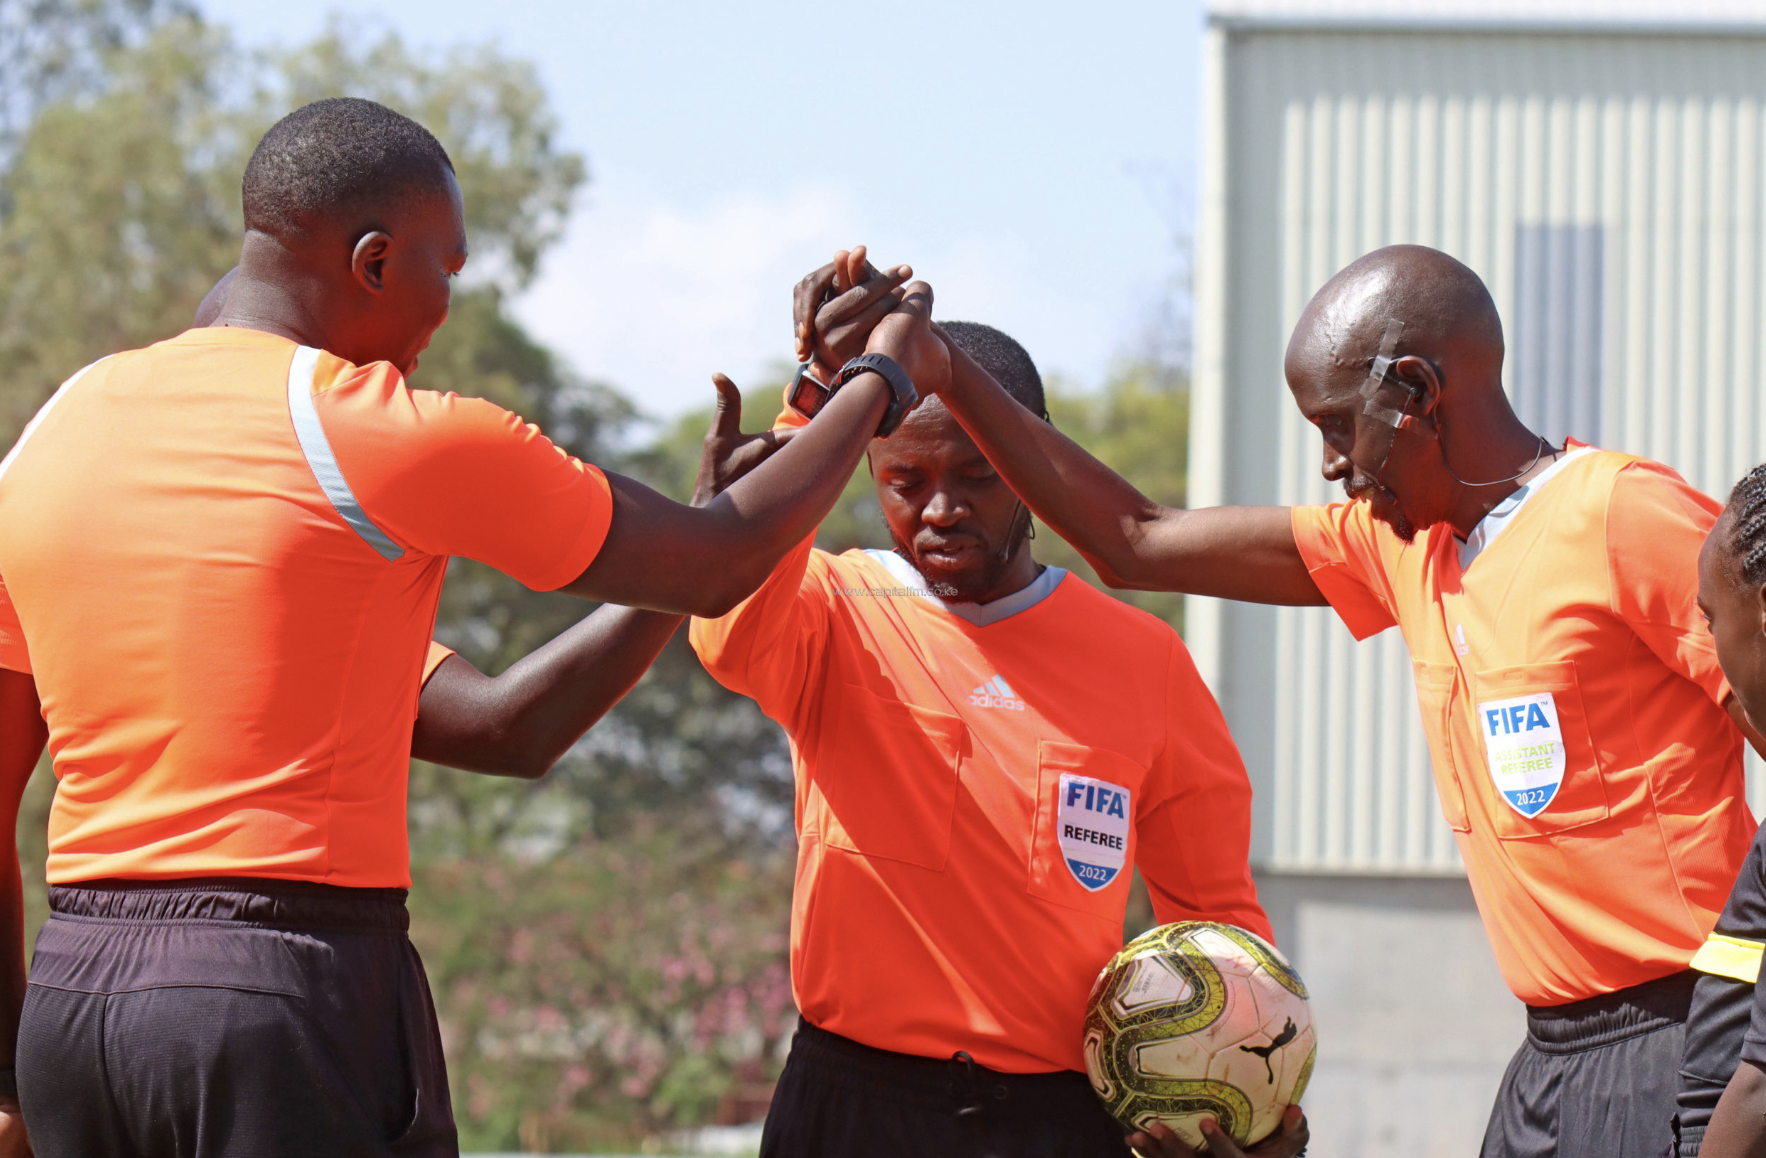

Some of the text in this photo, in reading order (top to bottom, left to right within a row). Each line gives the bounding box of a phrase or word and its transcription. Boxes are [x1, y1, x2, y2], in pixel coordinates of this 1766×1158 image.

[967, 693, 1024, 711] adidas
[1486, 702, 1550, 736] FIFA
[1495, 742, 1555, 761] ASSISTANT
[1501, 757, 1553, 775] REFEREE
[1067, 782, 1124, 819] FIFA
[1516, 790, 1545, 806] 2022
[1064, 824, 1122, 850] REFEREE
[1079, 865, 1107, 881] 2022
